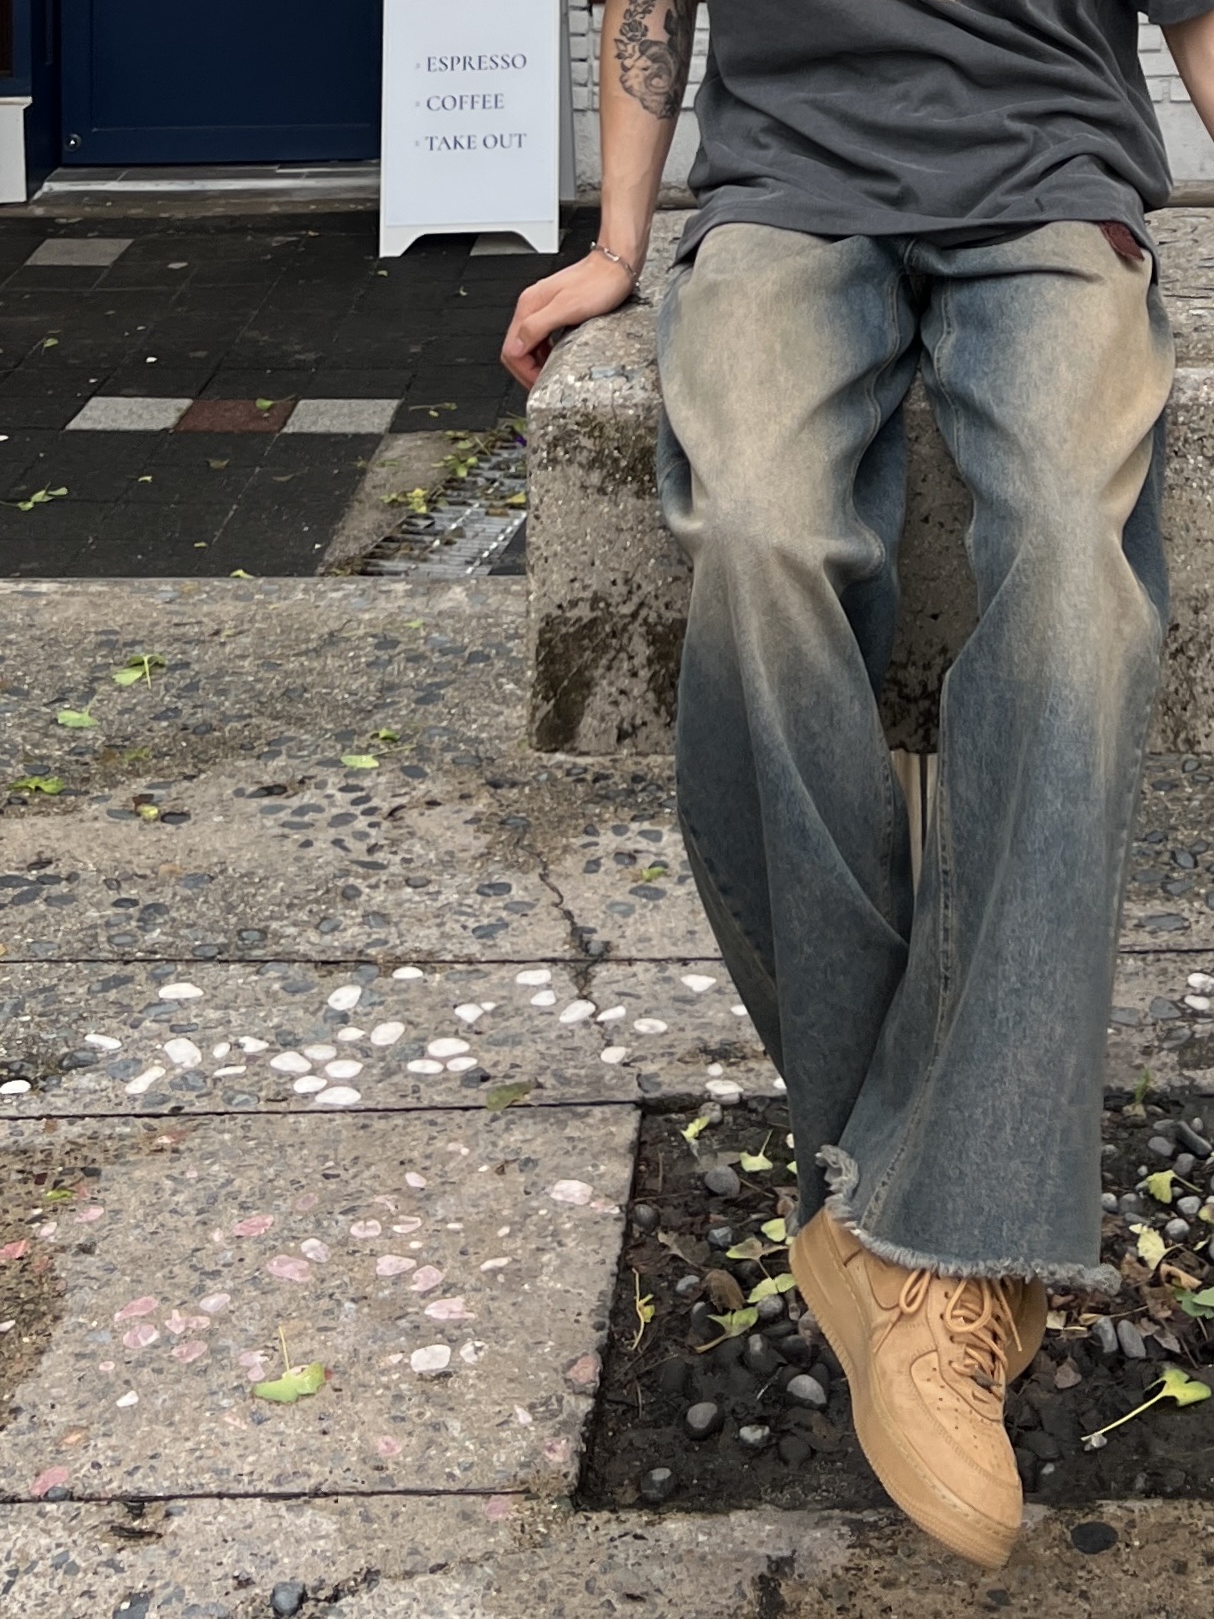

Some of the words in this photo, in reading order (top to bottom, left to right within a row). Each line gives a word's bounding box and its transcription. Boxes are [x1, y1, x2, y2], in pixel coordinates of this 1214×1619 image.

[426, 53, 527, 73] ESPRESSO
[426, 93, 505, 112] COFFEE
[425, 134, 477, 152] TAKE
[482, 132, 527, 150] OUT
